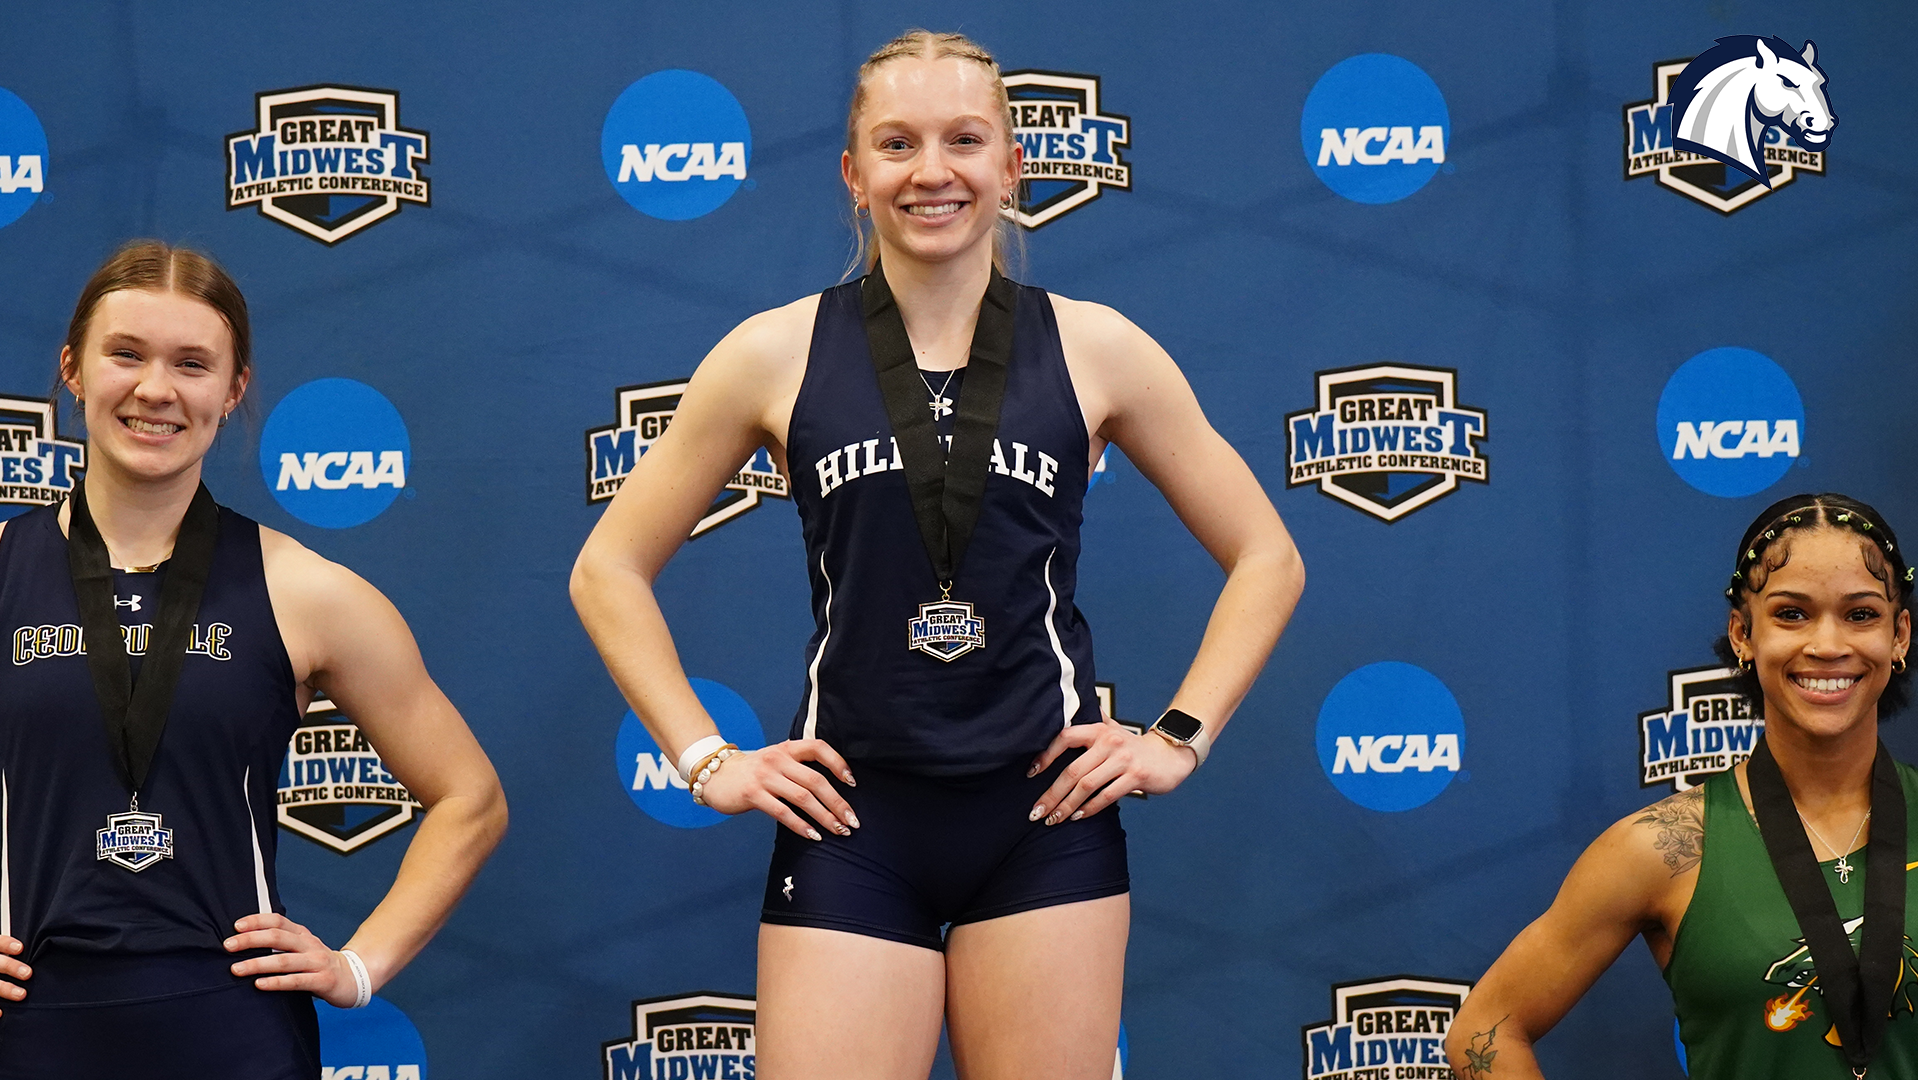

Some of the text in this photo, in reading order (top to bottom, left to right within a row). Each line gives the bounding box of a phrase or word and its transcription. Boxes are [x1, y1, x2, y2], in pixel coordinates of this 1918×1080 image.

[1010, 105, 1076, 128] EAT
[280, 120, 374, 145] GREAT
[1014, 117, 1123, 164] WEST
[233, 133, 422, 184] MIDWEST
[1317, 126, 1445, 166] NCAA
[617, 142, 747, 182] NCAA
[235, 176, 424, 200] ATHLETIC CONFERENCE
[1339, 398, 1432, 423] GREAT
[1293, 411, 1480, 463] MIDWEST
[1672, 419, 1800, 459] NCAA
[276, 451, 405, 490] NCAA
[815, 435, 1059, 498] HILLALE
[1295, 454, 1482, 479] ATHLETIC CONFERENCE
[912, 620, 980, 638] MIDWEST
[929, 615, 963, 624] GREAT
[295, 729, 370, 755] GREA
[1332, 734, 1461, 774] NCAA
[1648, 754, 1725, 778] ATHLETIC
[102, 831, 168, 848] MIDWEST
[118, 826, 152, 835] GREAT
[1357, 1010, 1450, 1036] GREAT
[657, 1026, 751, 1053] GREAT
[610, 1042, 755, 1080] MIDWES
